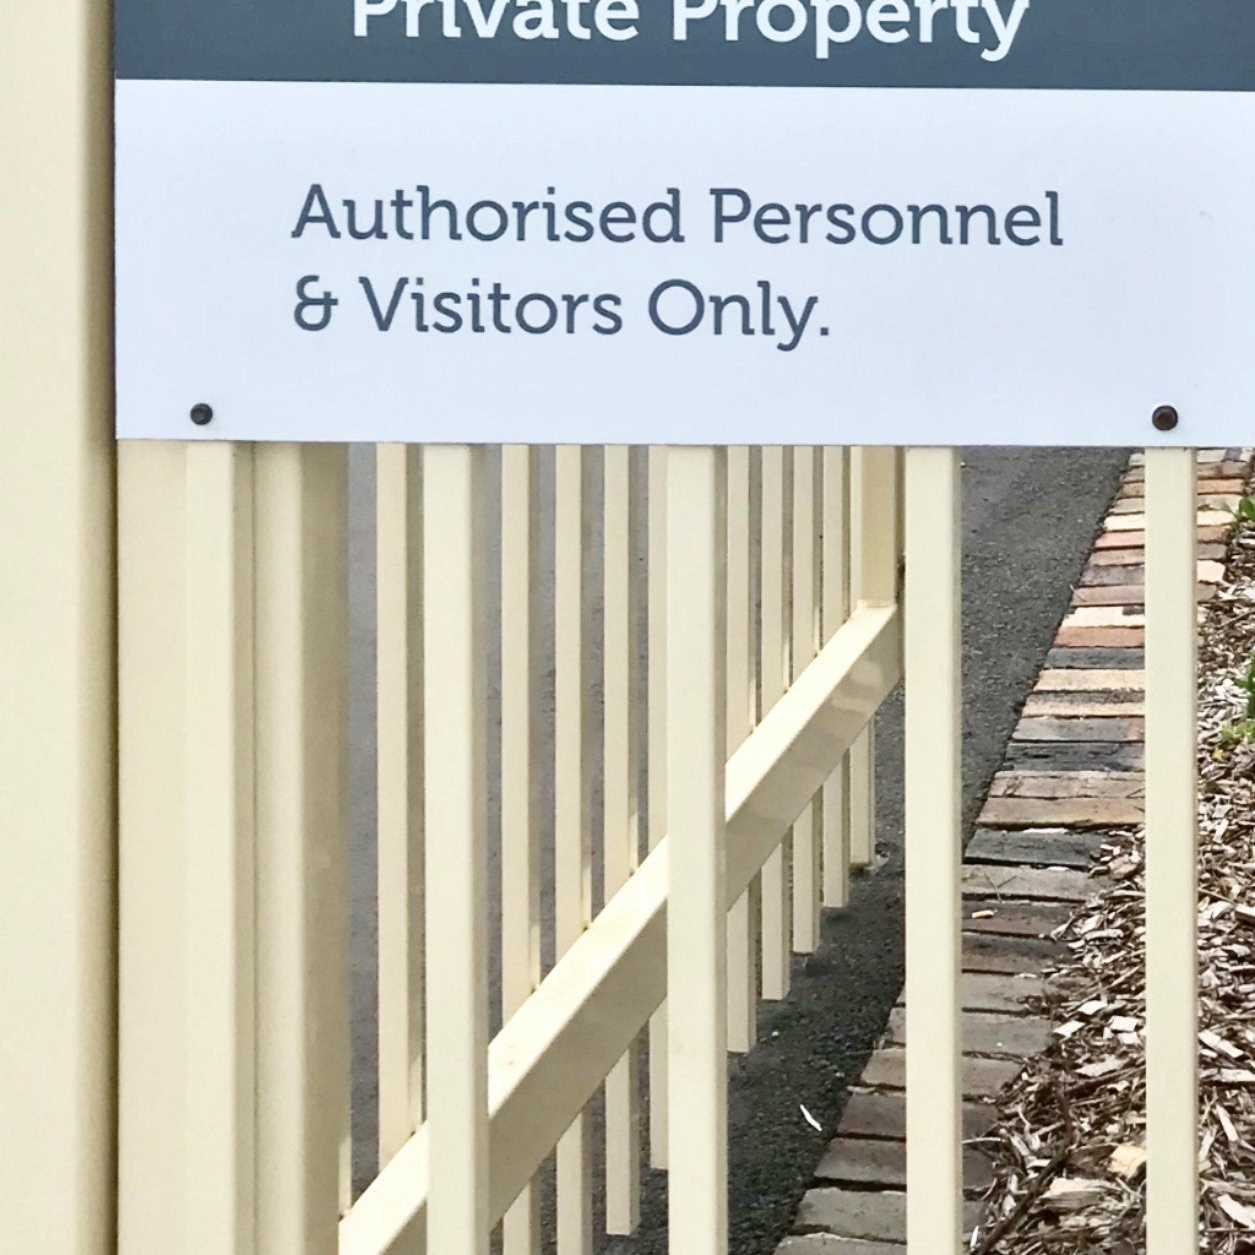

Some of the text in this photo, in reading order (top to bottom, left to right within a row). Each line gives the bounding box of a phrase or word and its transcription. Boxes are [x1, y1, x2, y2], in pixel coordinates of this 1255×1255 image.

[290, 183, 1064, 247] Authorised Personnel
[293, 274, 830, 353] & Visitors Only.
